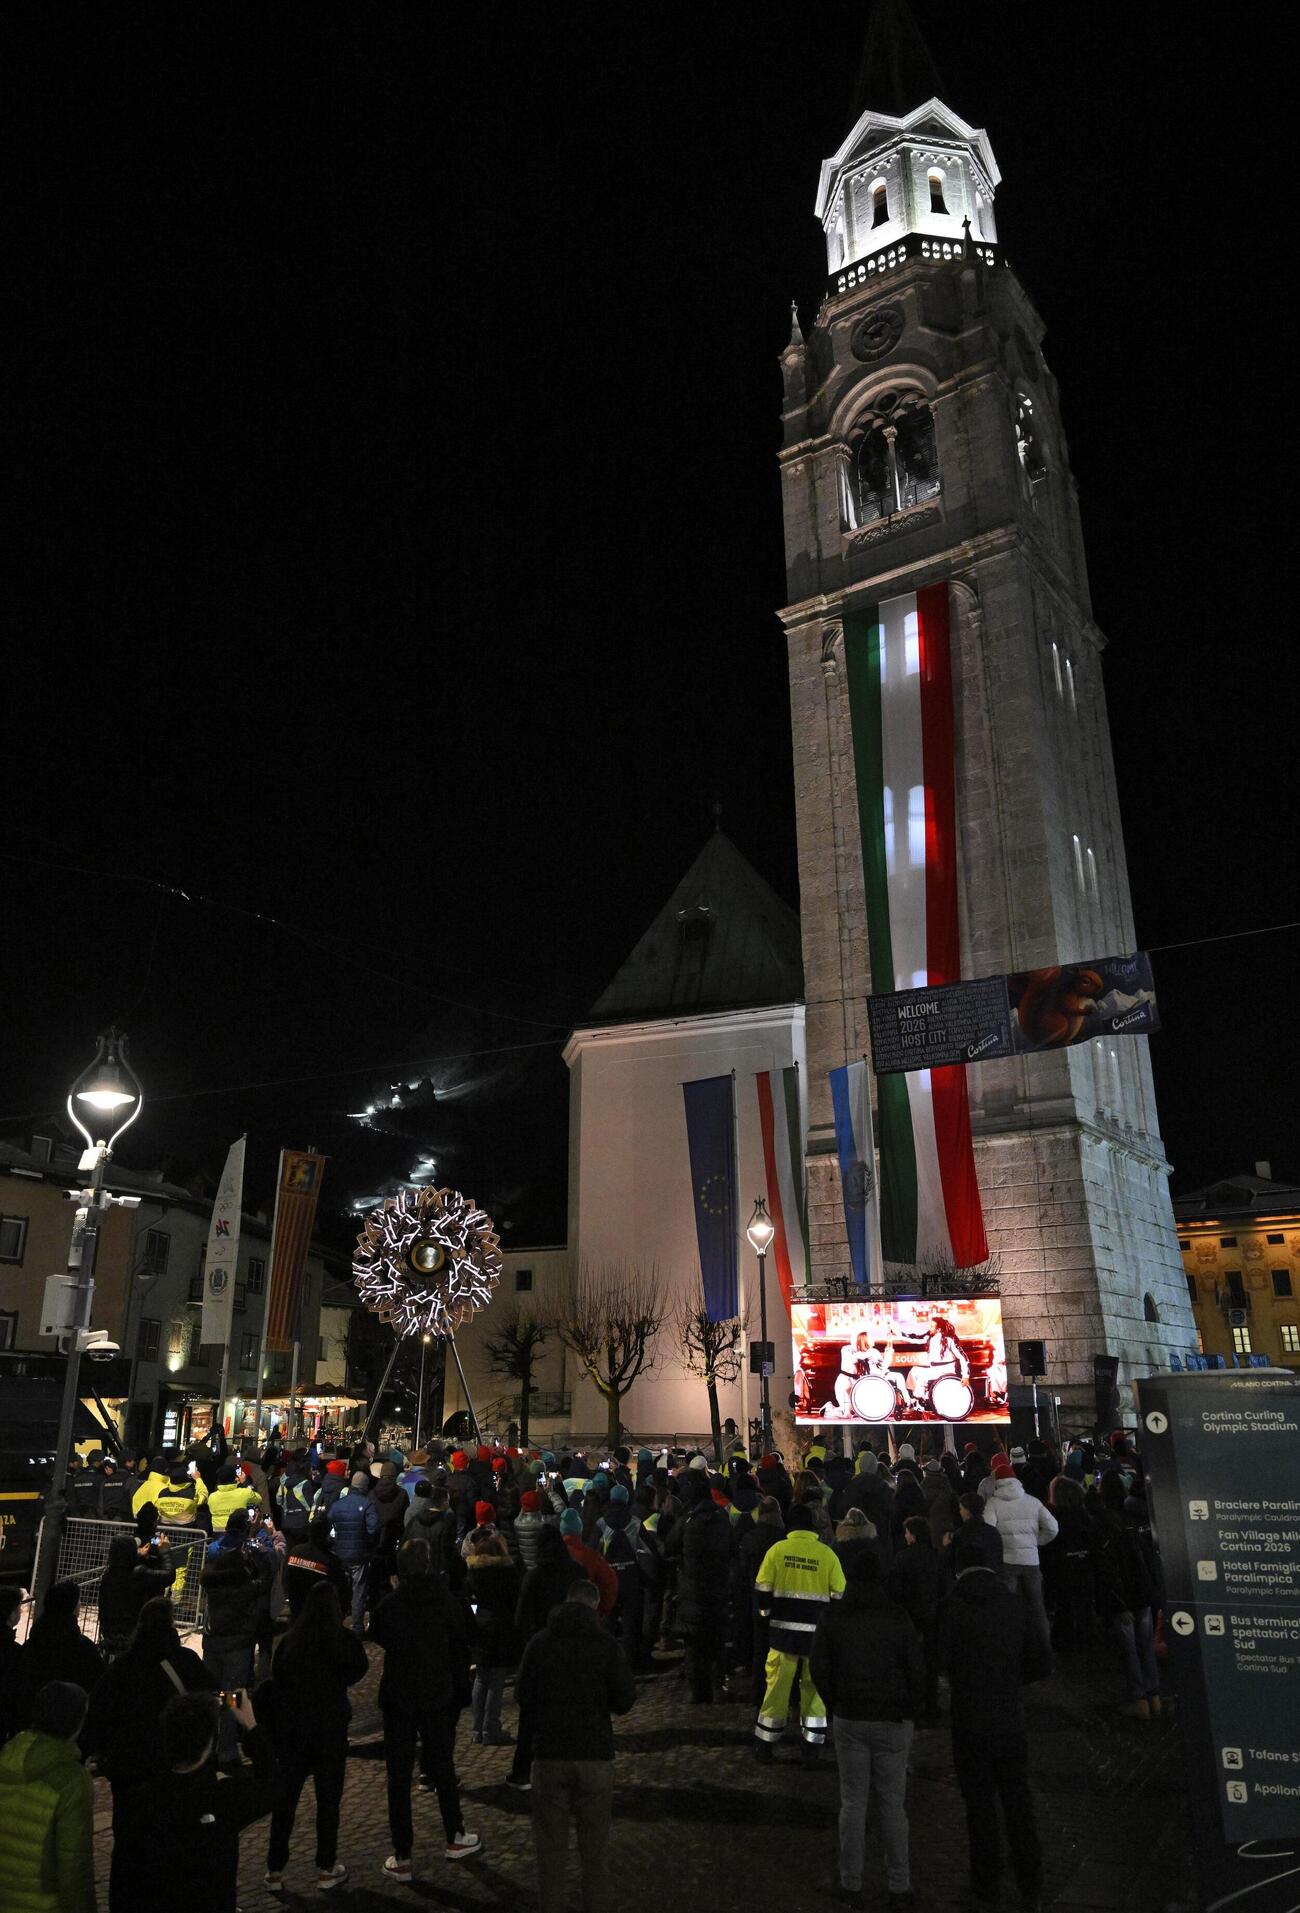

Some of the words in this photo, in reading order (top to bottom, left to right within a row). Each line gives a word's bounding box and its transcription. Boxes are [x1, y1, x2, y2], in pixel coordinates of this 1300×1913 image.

[898, 1001, 941, 1020] WELCOME
[901, 1018, 926, 1034] 2026
[1112, 1010, 1148, 1031] Cortina
[901, 1032, 926, 1049] HOST
[928, 1029, 947, 1044] CITY
[967, 1033, 999, 1058] Cortina
[1201, 1410, 1242, 1421] Cortina
[1244, 1410, 1285, 1422] Curling
[1203, 1422, 1249, 1434] Olympic
[1251, 1422, 1298, 1431] Stadium
[1214, 1500, 1260, 1510] Braciere
[1216, 1513, 1263, 1522] Paralympic
[1264, 1513, 1300, 1522] Cauldro
[1218, 1530, 1239, 1540] Fan
[1241, 1530, 1280, 1543] Village
[1282, 1531, 1300, 1541] Mil
[1220, 1541, 1262, 1552] Cortina
[1264, 1542, 1292, 1553] 2026
[1222, 1561, 1252, 1571] Hotel
[1224, 1572, 1293, 1585] Paralimpica
[1226, 1585, 1274, 1596] Paralympic
[1230, 1615, 1252, 1625] Bus
[1232, 1628, 1288, 1639] spettatori
[1234, 1639, 1256, 1650] Sud
[1235, 1653, 1277, 1663] Spectator
[1248, 1749, 1289, 1761] Tofane
